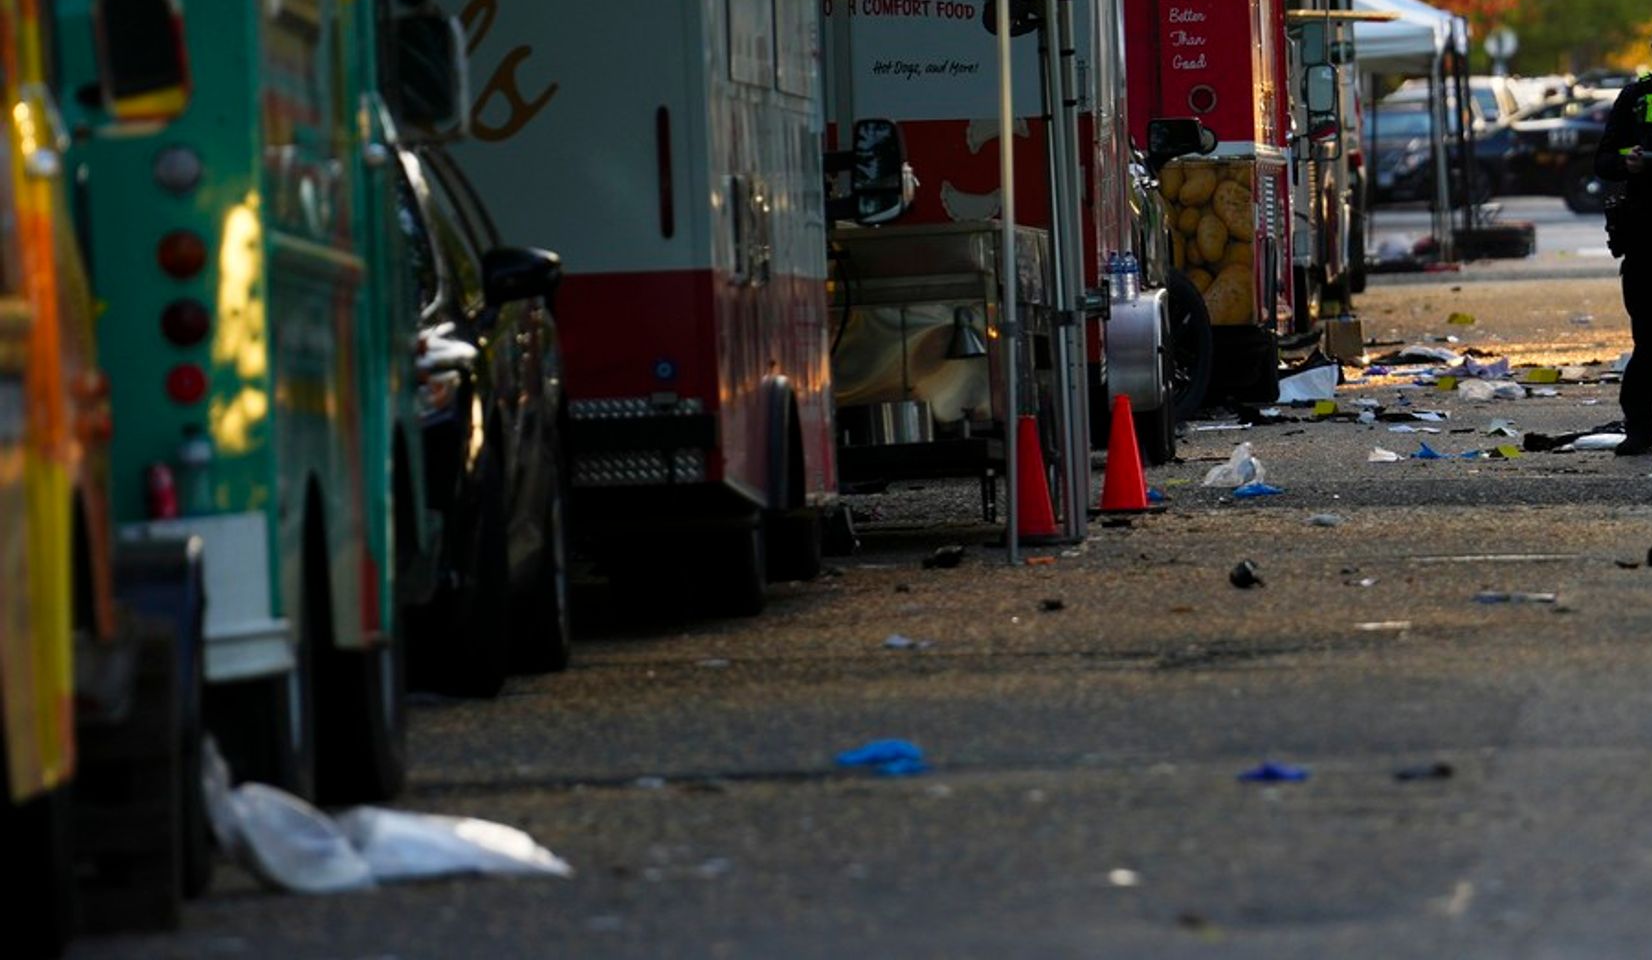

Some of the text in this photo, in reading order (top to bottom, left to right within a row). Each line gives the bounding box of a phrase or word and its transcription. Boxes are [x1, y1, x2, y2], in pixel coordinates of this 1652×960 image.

[936, 0, 976, 19] FOOD
[1168, 7, 1208, 24] Better
[1169, 30, 1207, 47] Than
[873, 61, 891, 74] Hot
[925, 60, 948, 73] and
